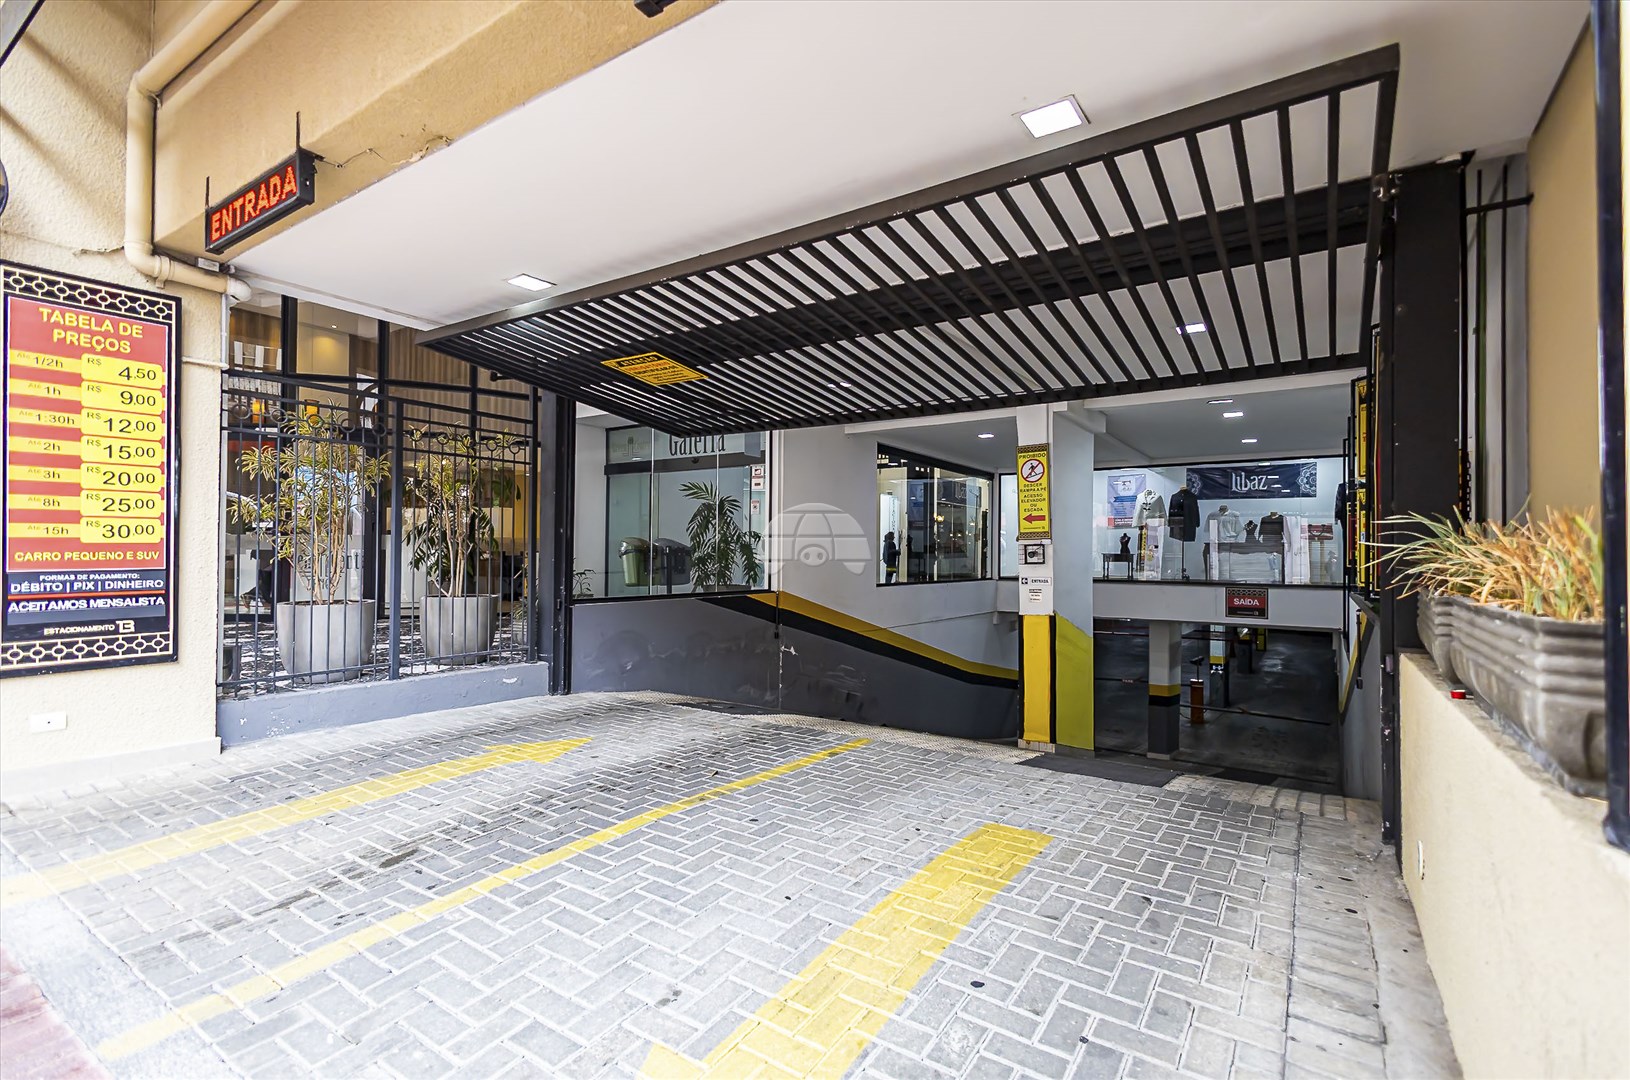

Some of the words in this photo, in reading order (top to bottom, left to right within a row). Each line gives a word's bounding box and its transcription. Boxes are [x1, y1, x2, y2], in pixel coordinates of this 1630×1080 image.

[210, 165, 298, 242] ENTRADA
[39, 307, 114, 333] TABELA
[118, 322, 144, 338] DE
[53, 328, 131, 353] PREÇOS
[34, 356, 63, 368] 1/2h
[87, 357, 102, 366] R$
[118, 366, 157, 381] 4,50
[44, 386, 61, 395] 1h
[87, 384, 102, 393] R$
[120, 391, 156, 406] 9,00
[35, 413, 75, 425] 1:30h
[87, 411, 101, 420] R$
[103, 418, 156, 433] 12,00
[43, 442, 61, 451] 2h
[87, 439, 101, 447] R$
[103, 444, 156, 460] 15,00
[1019, 452, 1046, 460] PROIBIDO
[43, 470, 61, 479] 3h
[86, 466, 100, 474] R$
[102, 470, 156, 486] 20,00
[42, 498, 61, 507] 8h
[86, 493, 100, 501] R$
[102, 497, 156, 512] 25,00
[43, 526, 69, 535] 15h
[86, 520, 100, 528] R$
[101, 524, 156, 539] 30,00
[14, 551, 61, 562] CARRO
[64, 551, 124, 561] PEQUENO
[127, 551, 134, 560] E
[136, 551, 160, 560] SUV
[10, 581, 63, 593] DÉBITO
[73, 581, 95, 591] PIX
[105, 579, 164, 590] DINHEIRO
[8, 599, 87, 613] ACEITAMOS
[89, 597, 165, 608] MENSALISTA
[1233, 597, 1260, 606] SAÍDA
[43, 624, 115, 636] ESTACIONAMENTO
